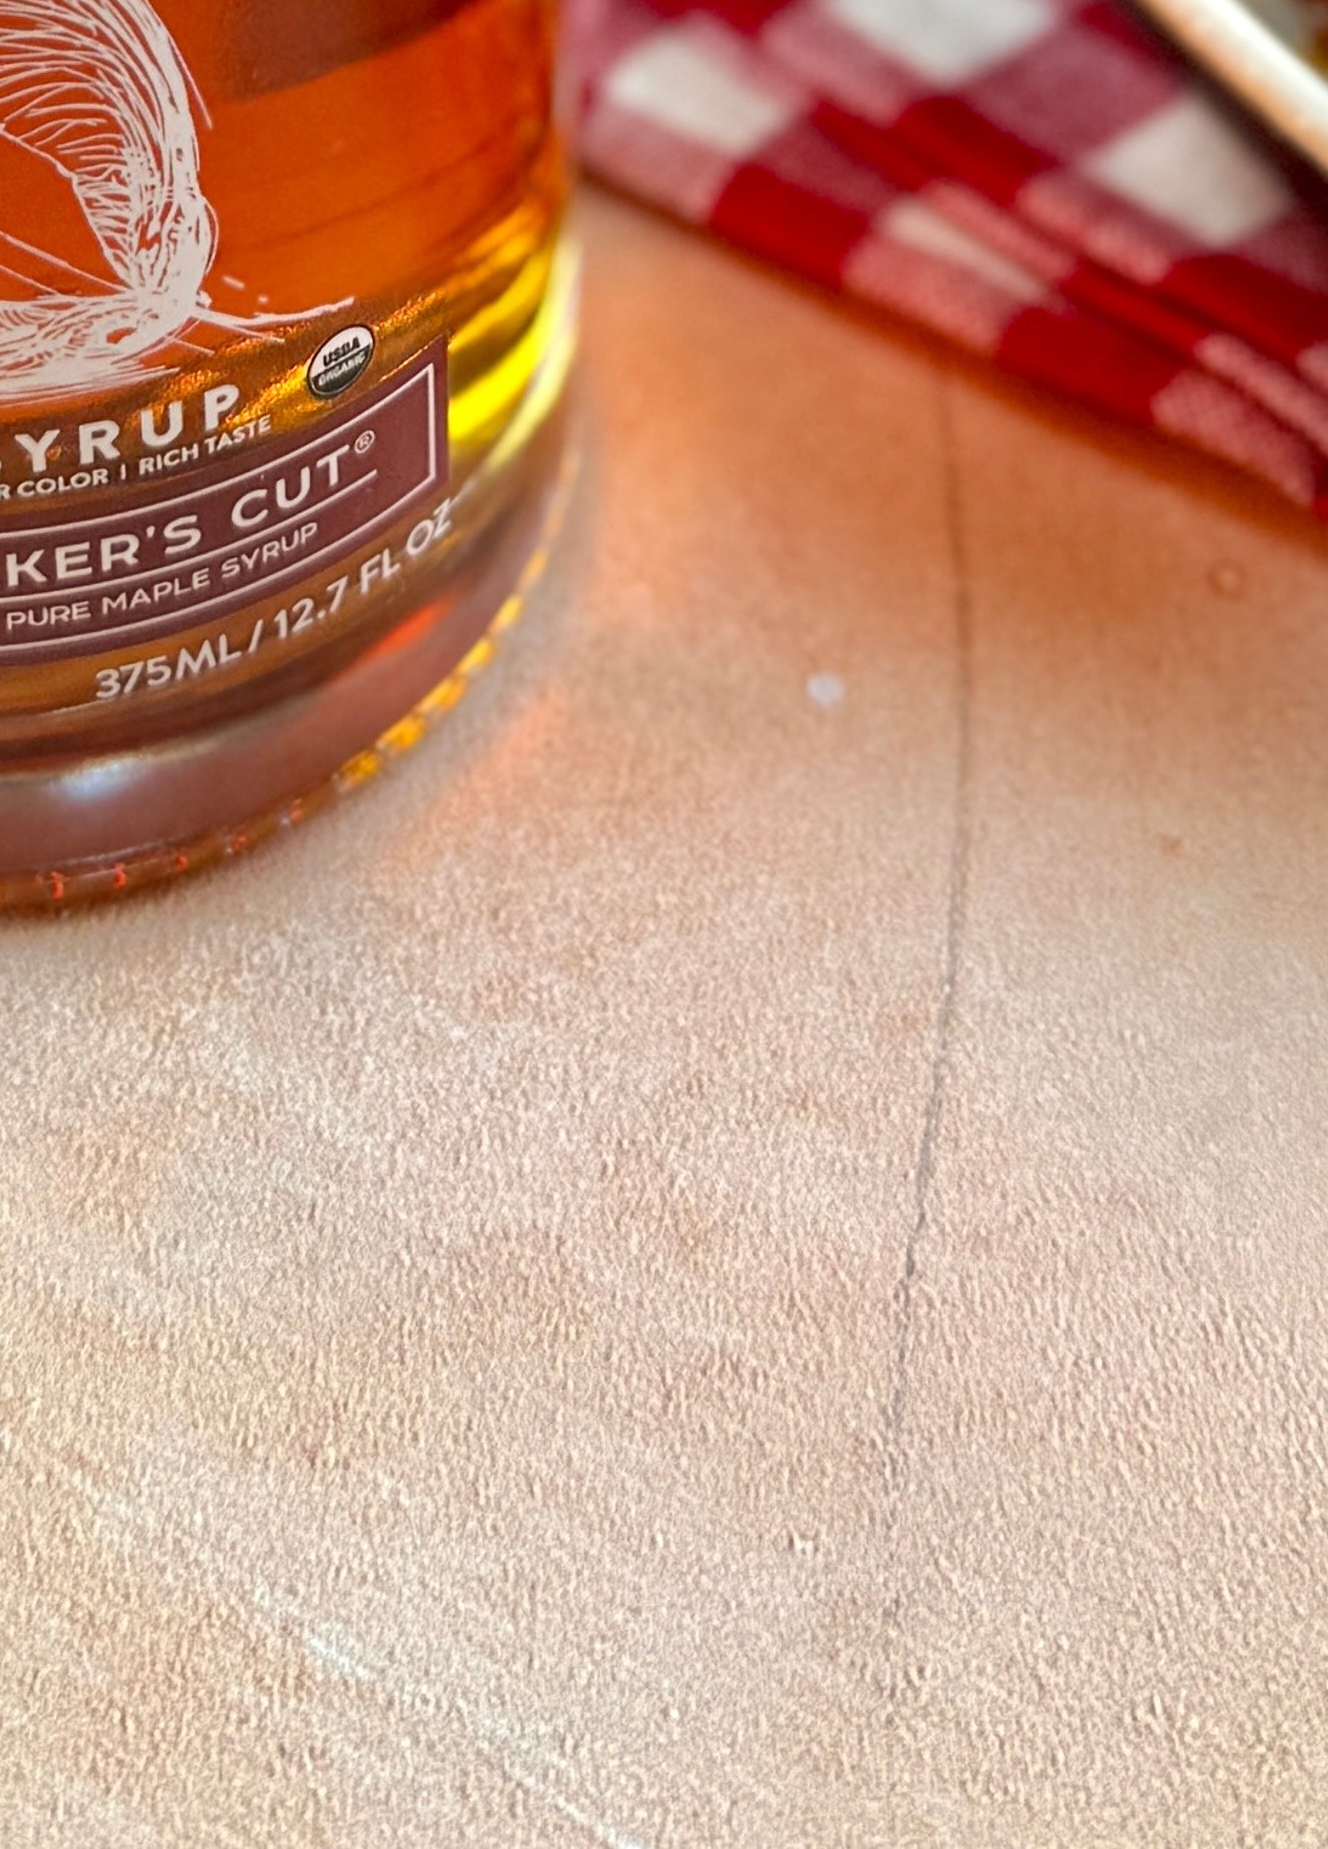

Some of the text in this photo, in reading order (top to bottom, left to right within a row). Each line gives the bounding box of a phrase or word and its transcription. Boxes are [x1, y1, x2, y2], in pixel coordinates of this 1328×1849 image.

[323, 336, 360, 367] USDA
[17, 468, 109, 499] COLOR
[139, 444, 199, 475] RICH
[205, 415, 271, 452] TASTE
[6, 600, 91, 630] PURE
[101, 568, 210, 614] MAPLE
[221, 521, 319, 578] SYRUP
[274, 579, 349, 638] 12.7
[359, 552, 401, 593] FL
[406, 498, 454, 555] OZ
